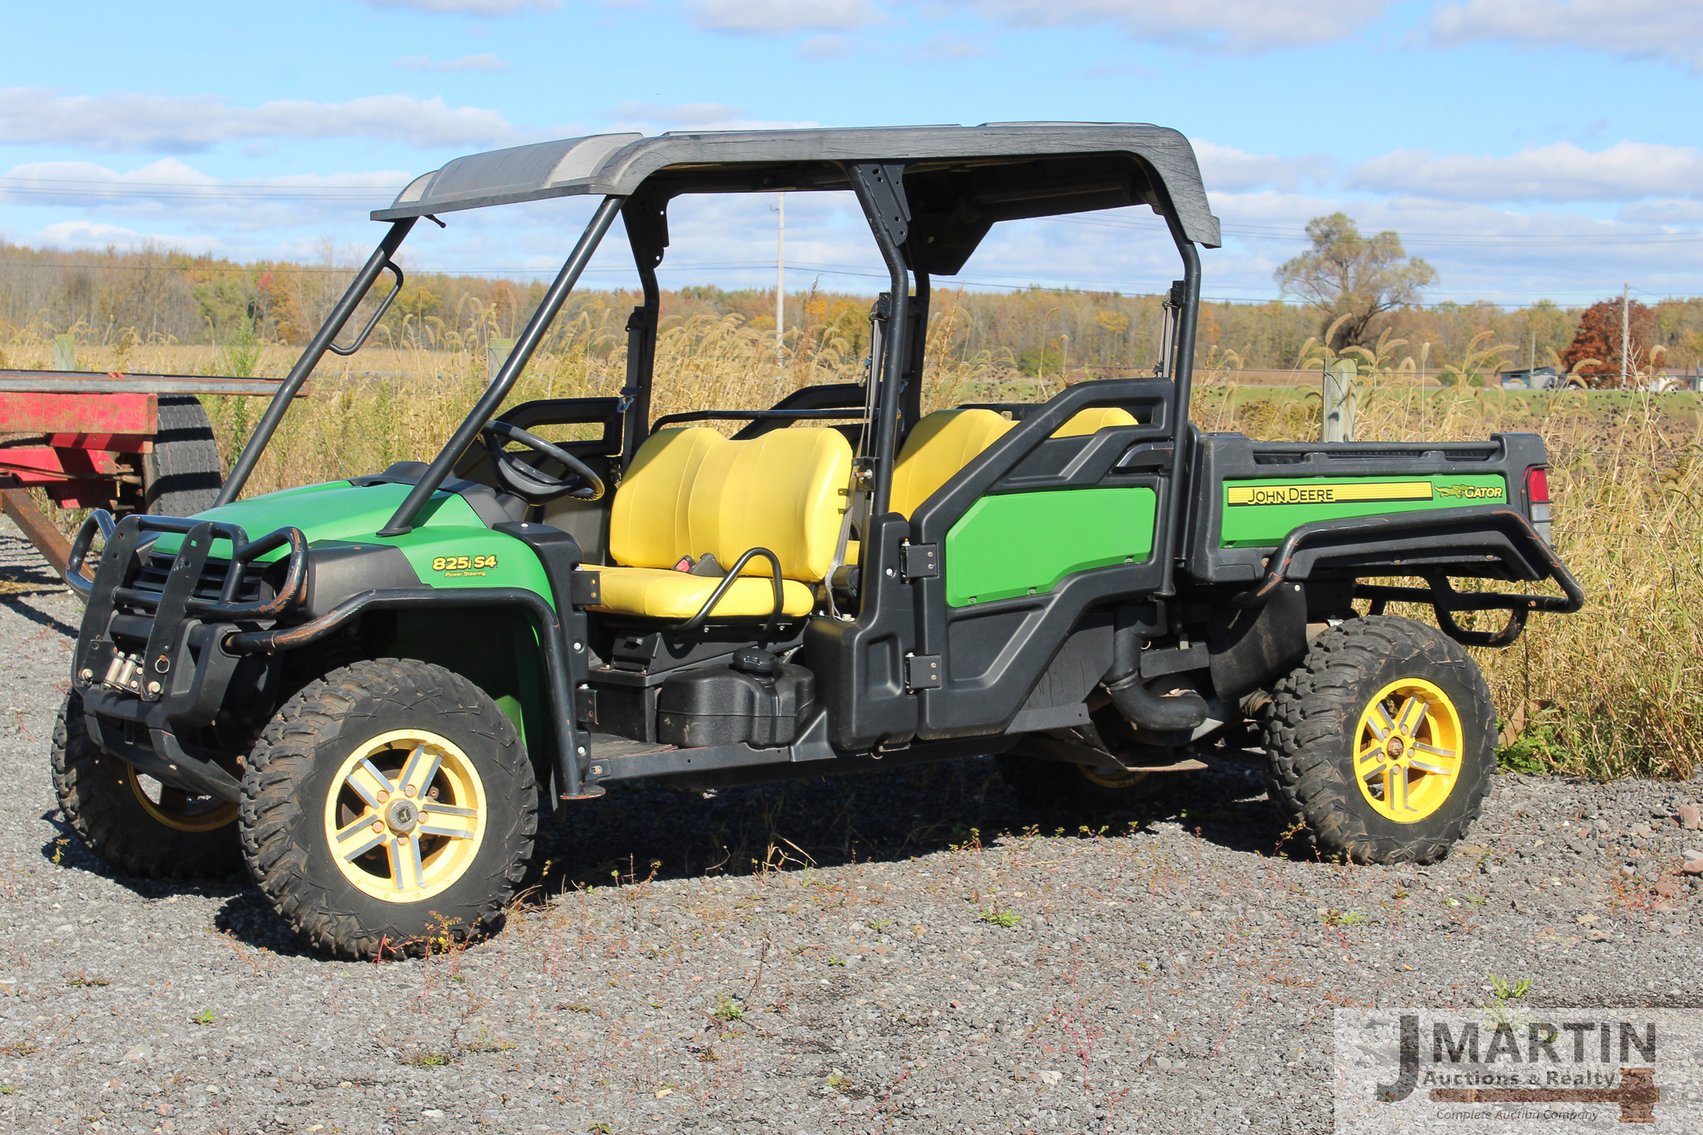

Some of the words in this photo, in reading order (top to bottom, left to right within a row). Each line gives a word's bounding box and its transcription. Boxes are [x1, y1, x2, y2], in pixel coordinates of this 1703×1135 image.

[1248, 488, 1286, 503] JOHN
[1288, 487, 1334, 501] DEERE
[1464, 485, 1503, 499] GATOR
[432, 556, 472, 571] 825i
[473, 555, 498, 569] S4
